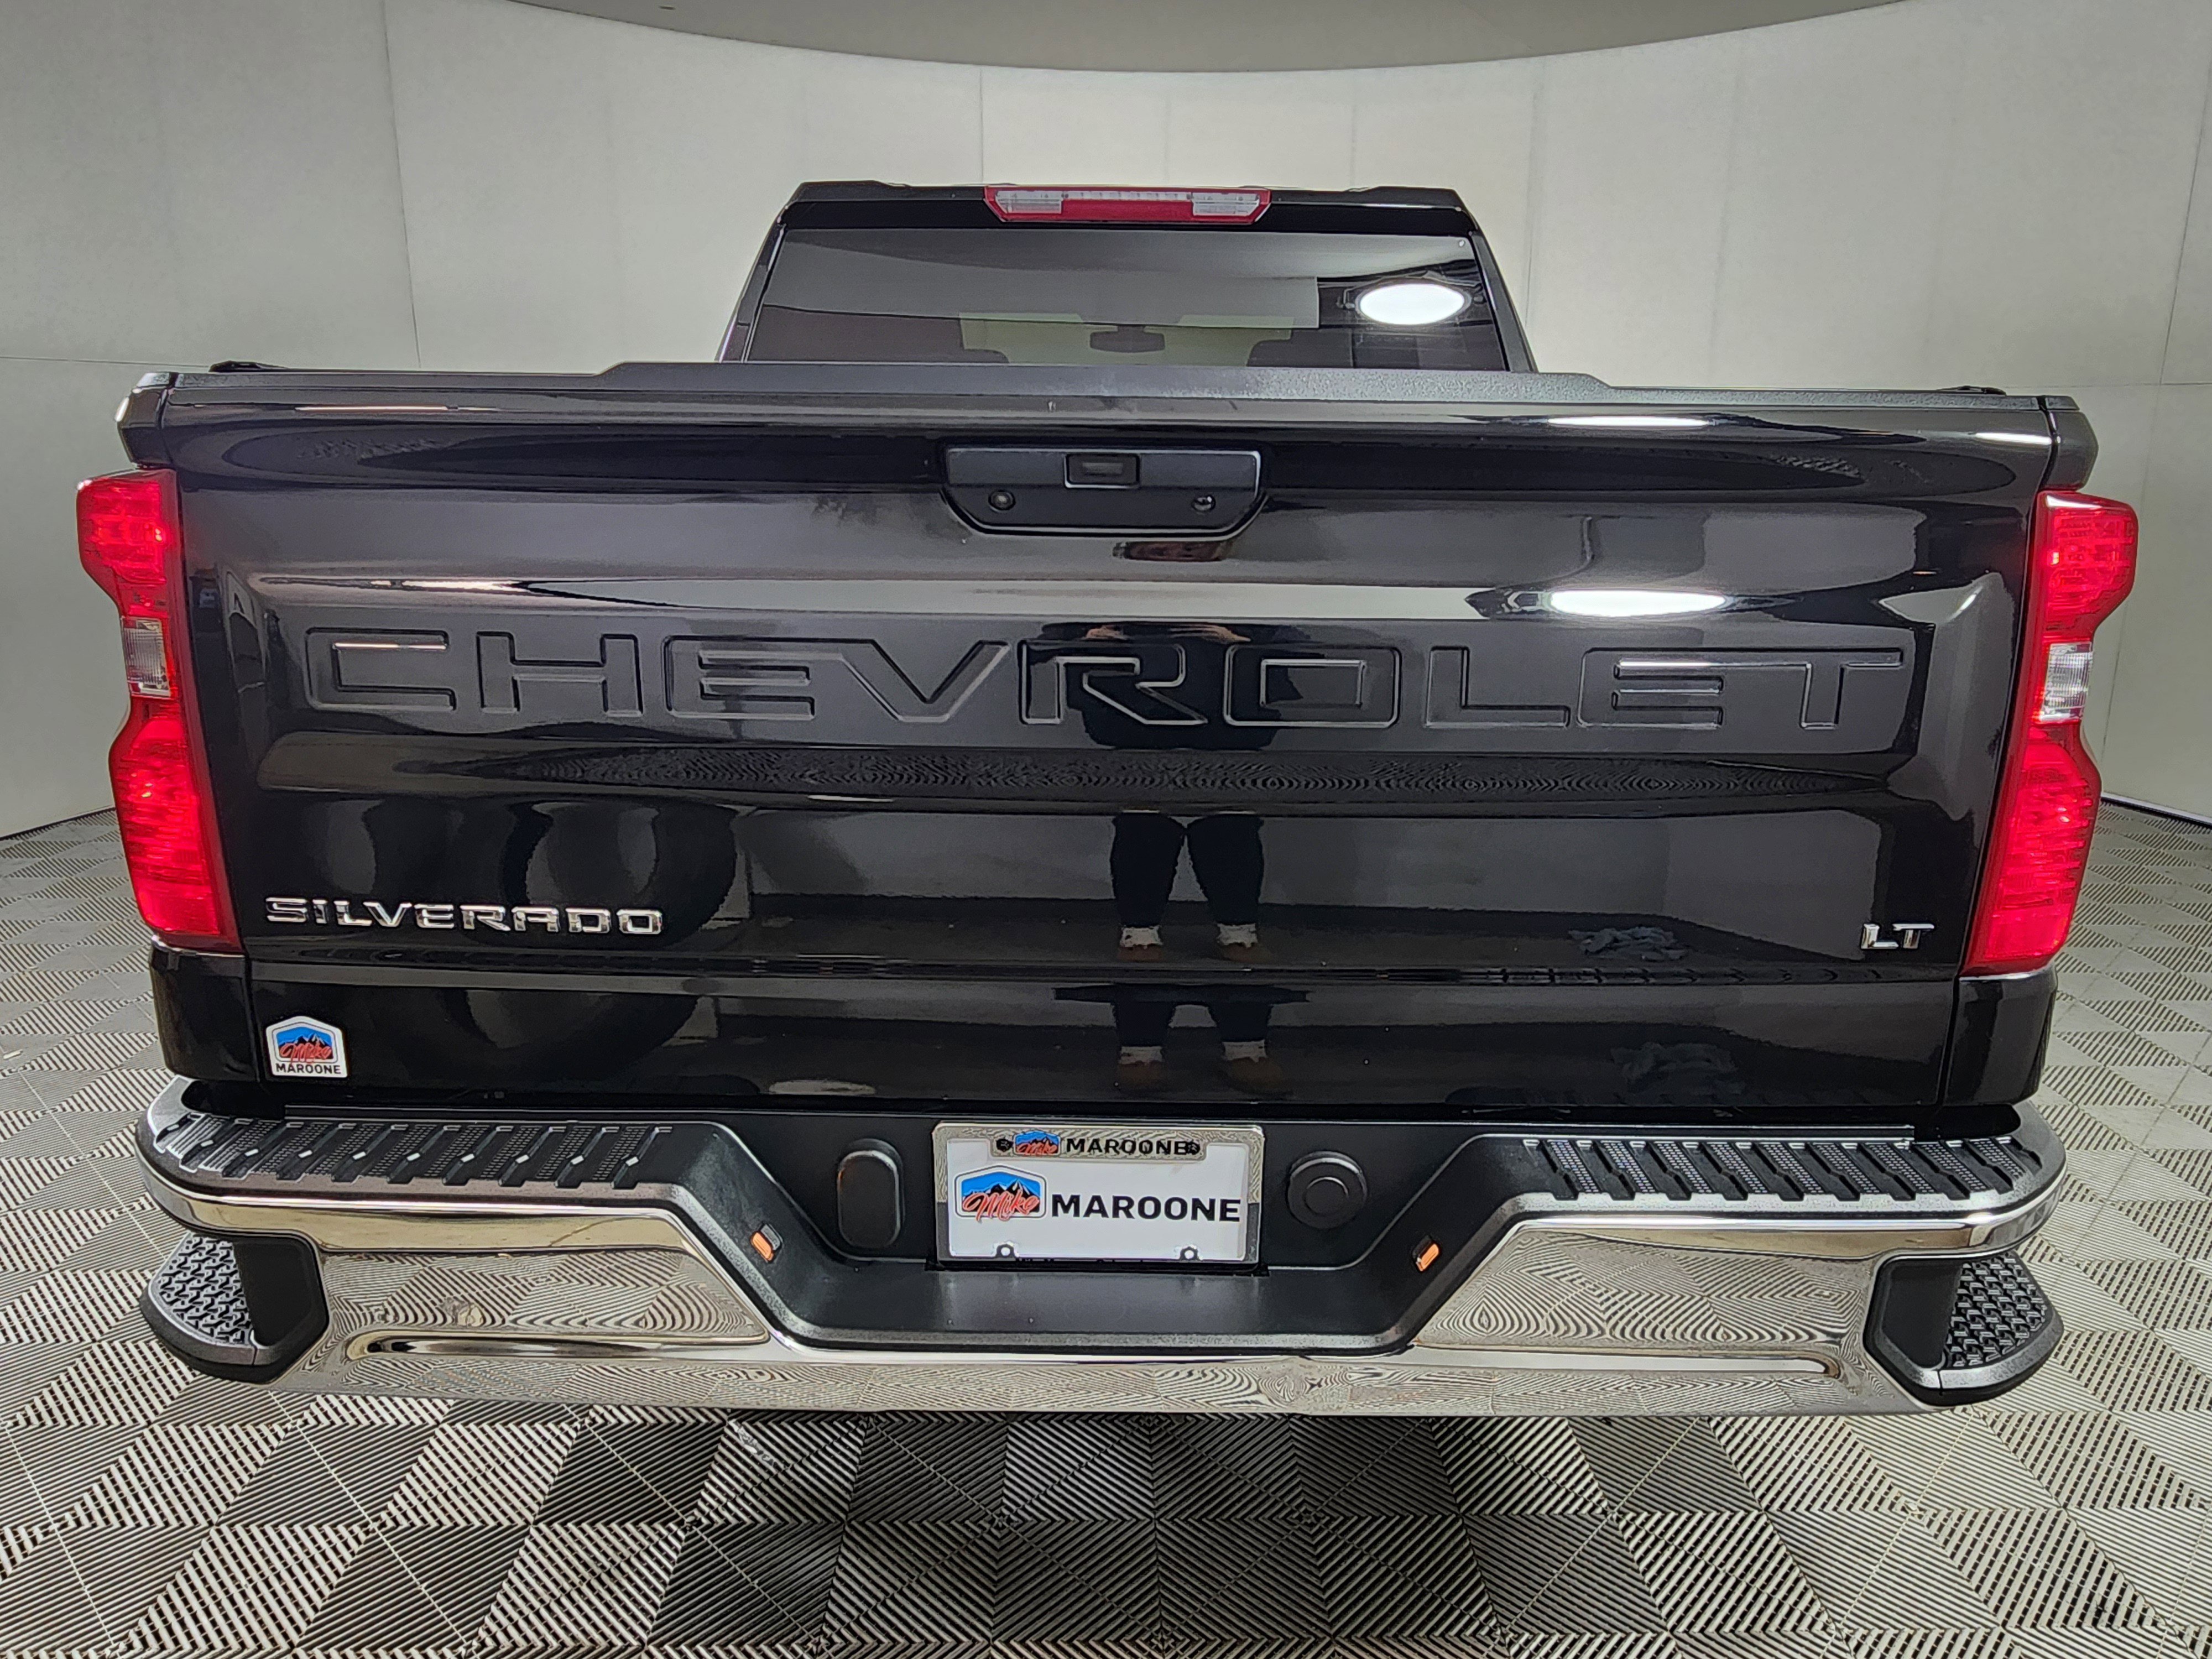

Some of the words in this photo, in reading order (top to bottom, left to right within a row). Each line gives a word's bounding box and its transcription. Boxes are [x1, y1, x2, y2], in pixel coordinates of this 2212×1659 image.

[305, 627, 1904, 730] CHEVROLET
[265, 896, 664, 935] SILVERADO
[1860, 923, 1934, 950] LT
[275, 1063, 341, 1074] MAROONE
[1066, 1138, 1187, 1156] MAROONE
[962, 1191, 1040, 1223] Mike
[1051, 1193, 1241, 1223] MAROONE
